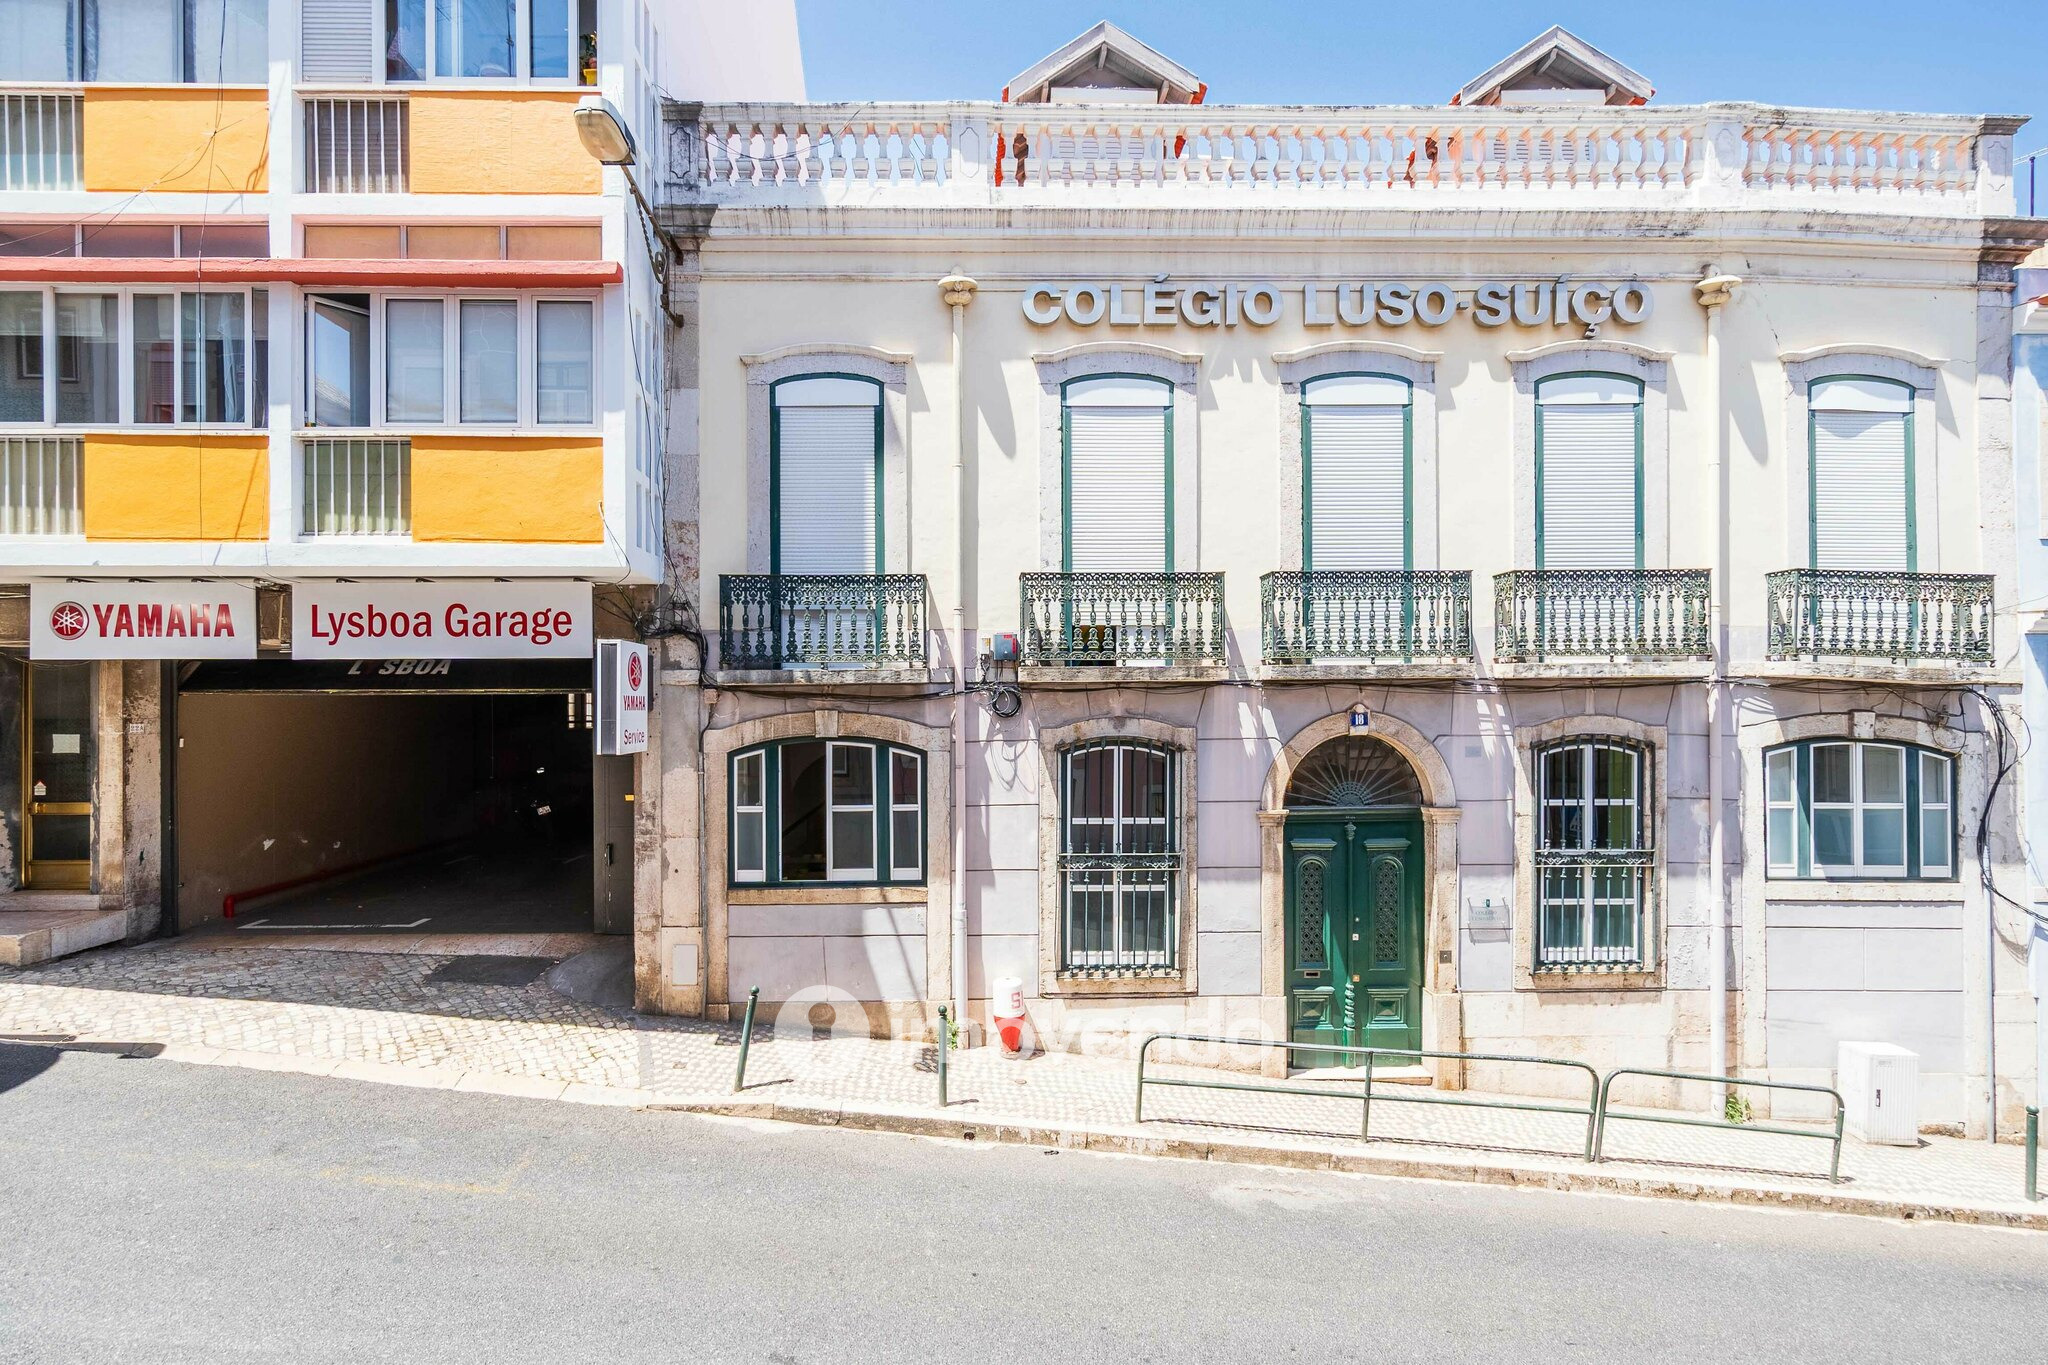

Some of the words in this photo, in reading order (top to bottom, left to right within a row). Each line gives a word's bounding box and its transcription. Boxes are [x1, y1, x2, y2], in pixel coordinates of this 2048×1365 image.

[1022, 272, 1284, 327] COLÉGIO
[1303, 272, 1655, 339] LUSO-SUÍÇO
[93, 603, 235, 638] YAMAHA
[311, 603, 433, 646] Lysboa
[444, 602, 573, 645] Garage
[623, 695, 646, 711] YAMAHA
[1355, 713, 1365, 726] 18
[623, 728, 645, 745] Service
